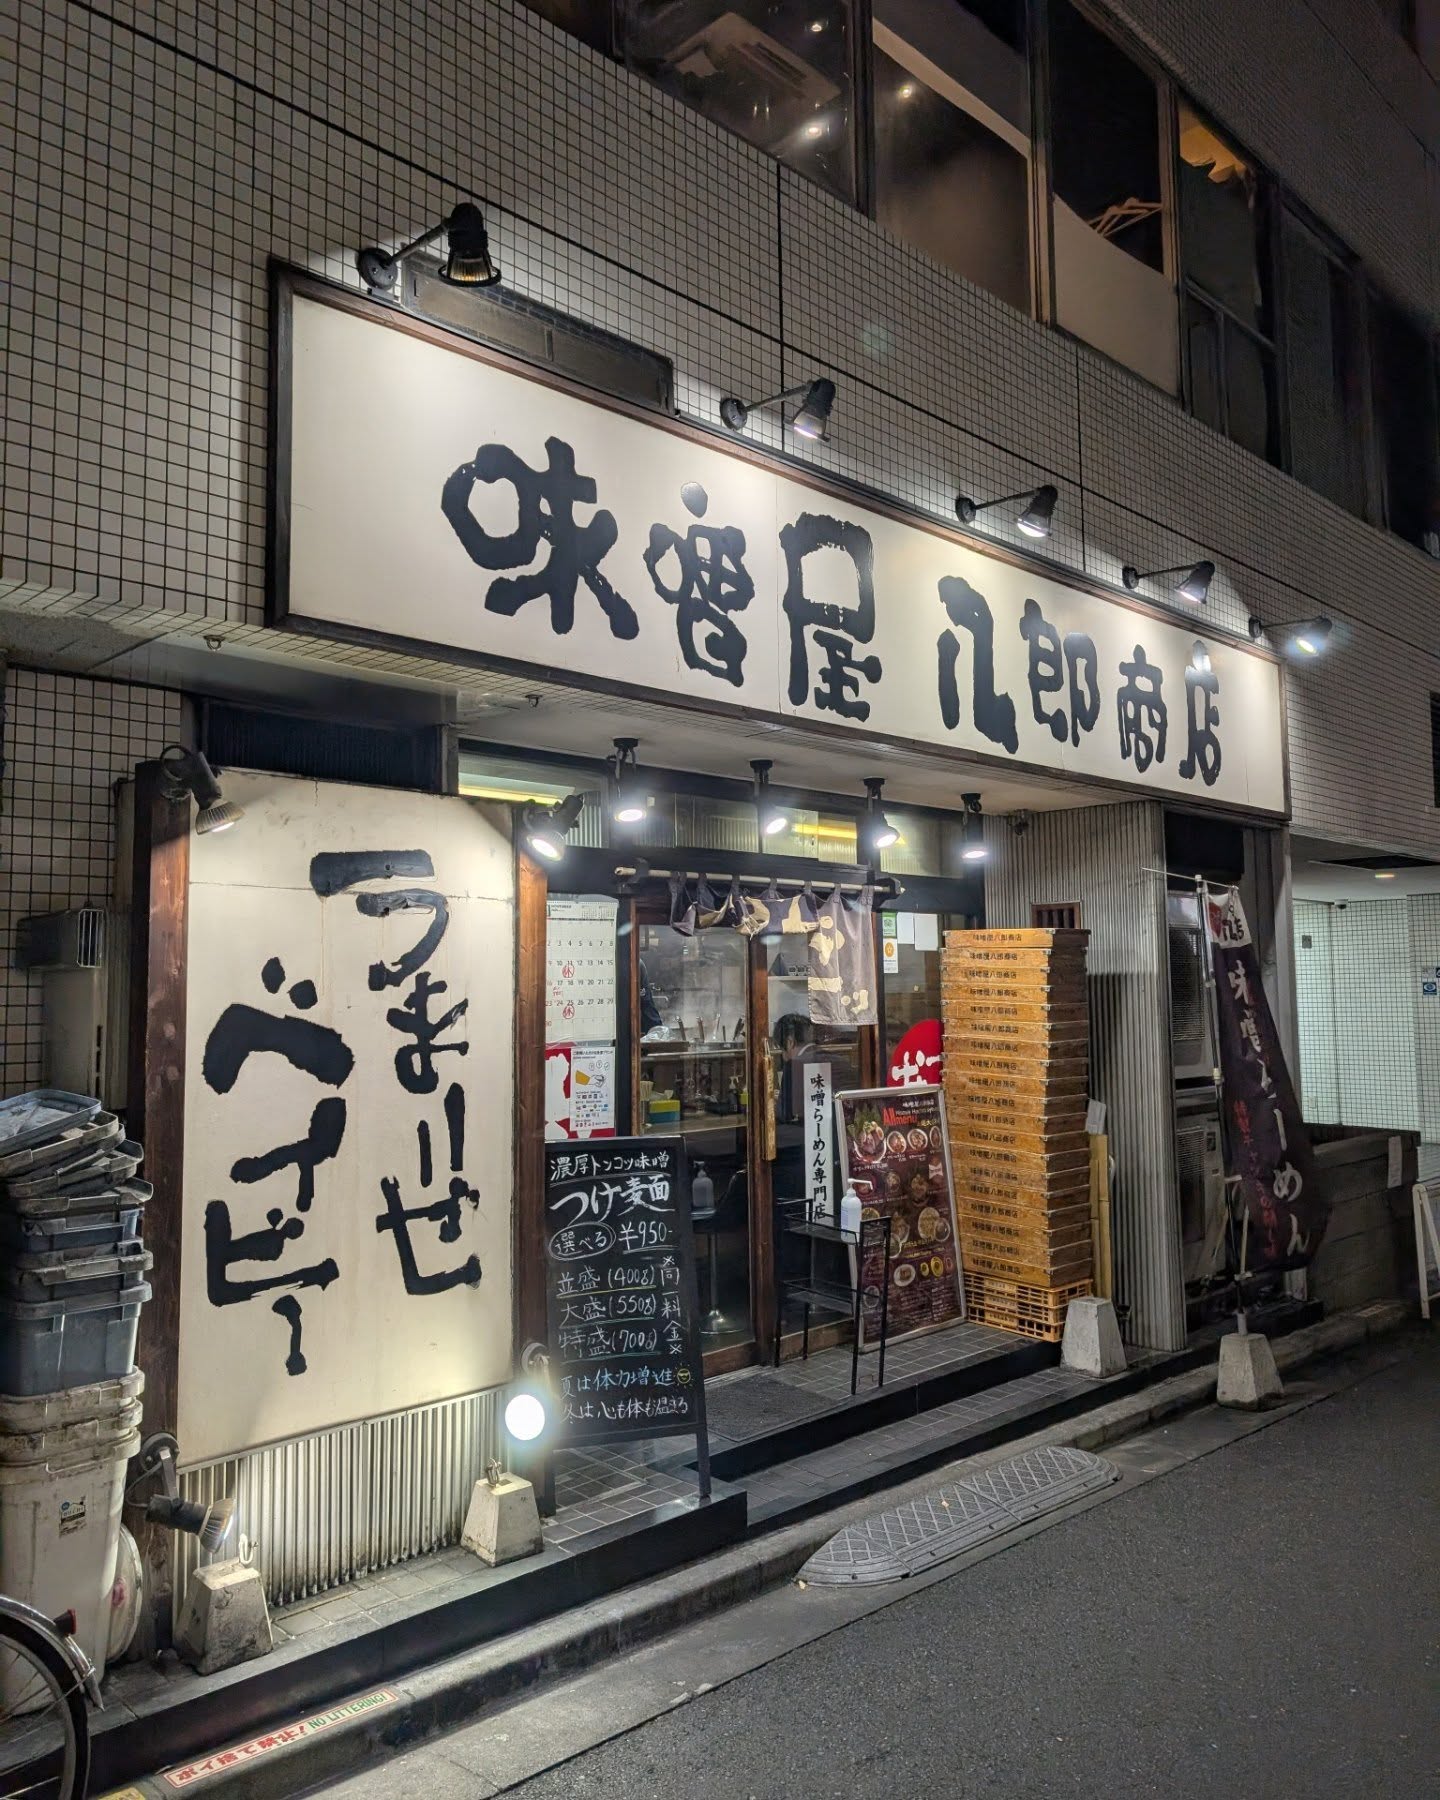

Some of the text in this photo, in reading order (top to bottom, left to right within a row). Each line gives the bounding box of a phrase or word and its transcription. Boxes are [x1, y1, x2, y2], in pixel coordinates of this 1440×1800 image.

[442, 436, 1222, 786] 味噌屋 八郎商店
[202, 957, 354, 1376] ベイビー
[551, 1151, 670, 1181] 濃厚トンコツ味噌
[810, 1073, 828, 1222] 味噌らーめん専門店
[550, 1173, 676, 1226] つけ麺
[554, 1231, 607, 1256] 選べる
[559, 1366, 673, 1399] 夏は体力増進
[308, 1694, 387, 1729] NO LITTERING!
